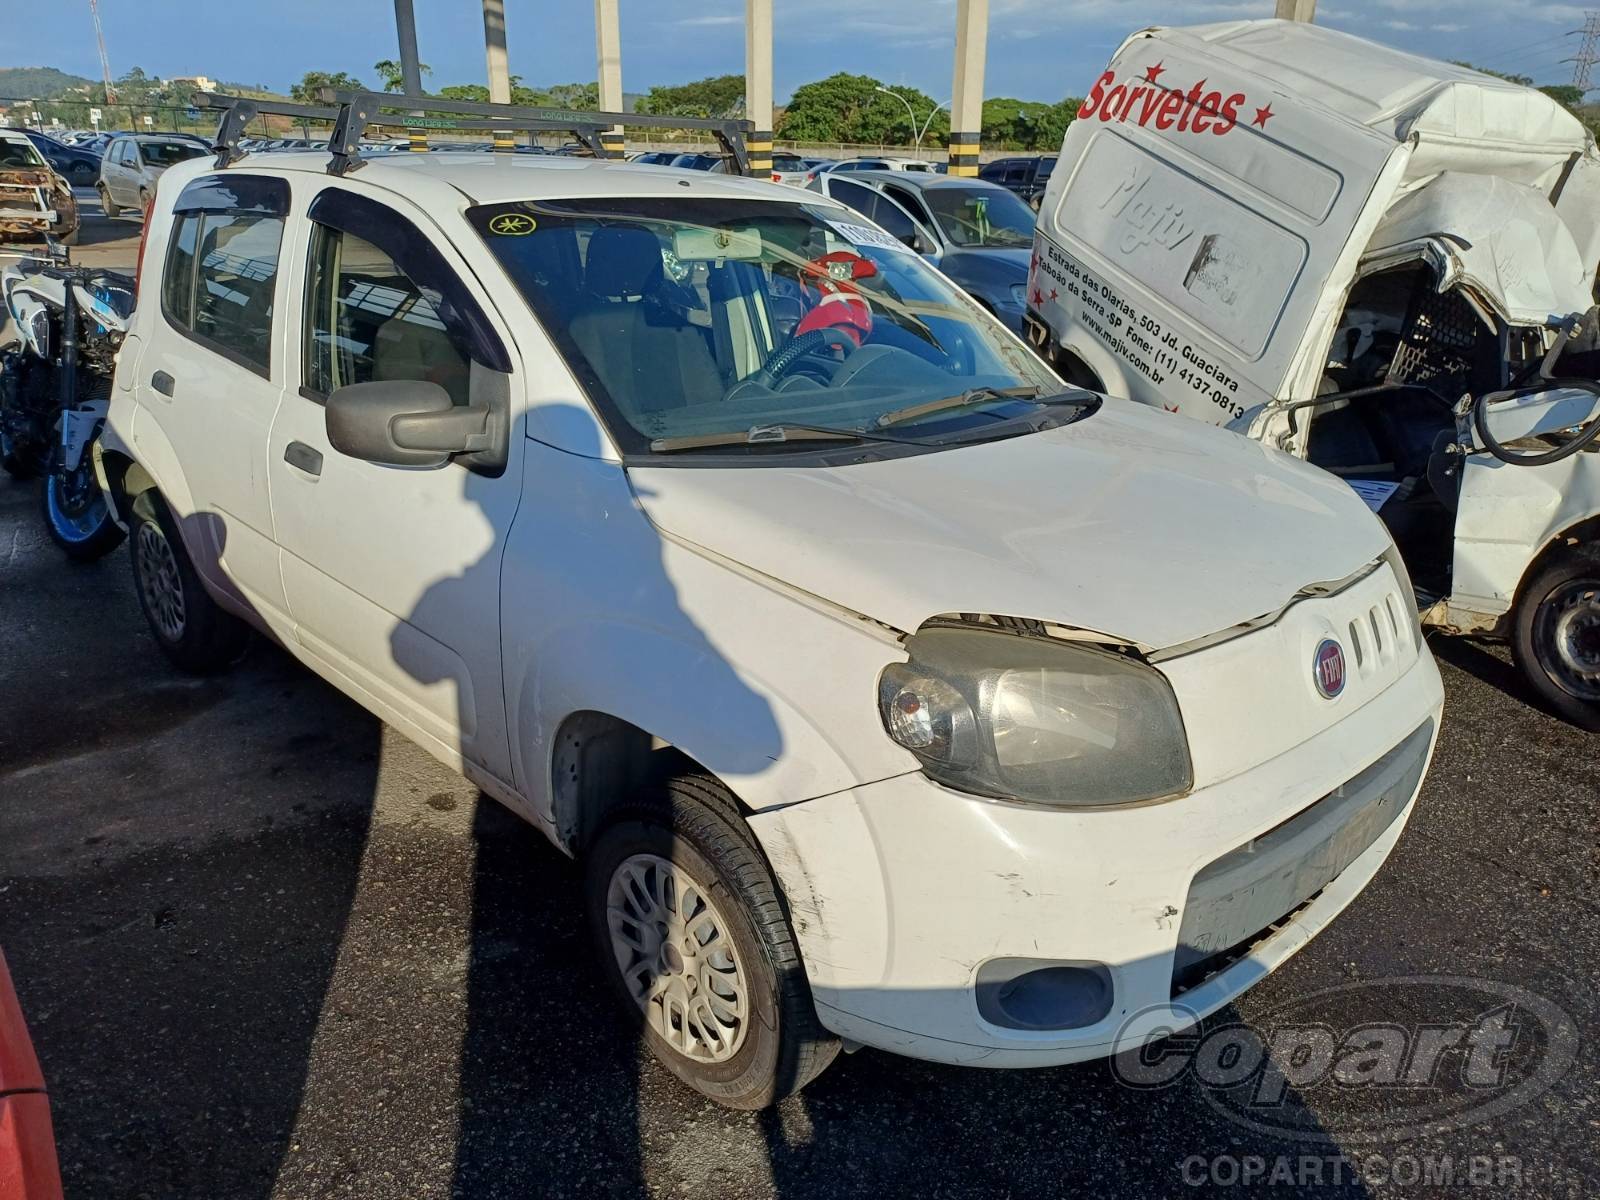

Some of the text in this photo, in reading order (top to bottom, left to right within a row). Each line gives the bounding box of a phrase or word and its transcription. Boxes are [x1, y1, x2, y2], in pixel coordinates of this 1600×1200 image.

[1077, 71, 1245, 135] Sorvetes
[1038, 256, 1066, 286] Taboão
[1068, 281, 1079, 296] da
[1081, 290, 1105, 317] Serra
[1126, 326, 1154, 355] Fone:
[1154, 349, 1178, 374] (11)
[1179, 368, 1244, 420] 4137-0813
[1048, 246, 1239, 392] Estrada das Olarias, 503 Jd. Guaciara
[1082, 311, 1165, 385] www.majiv.com.br
[1322, 654, 1341, 685] FIAT
